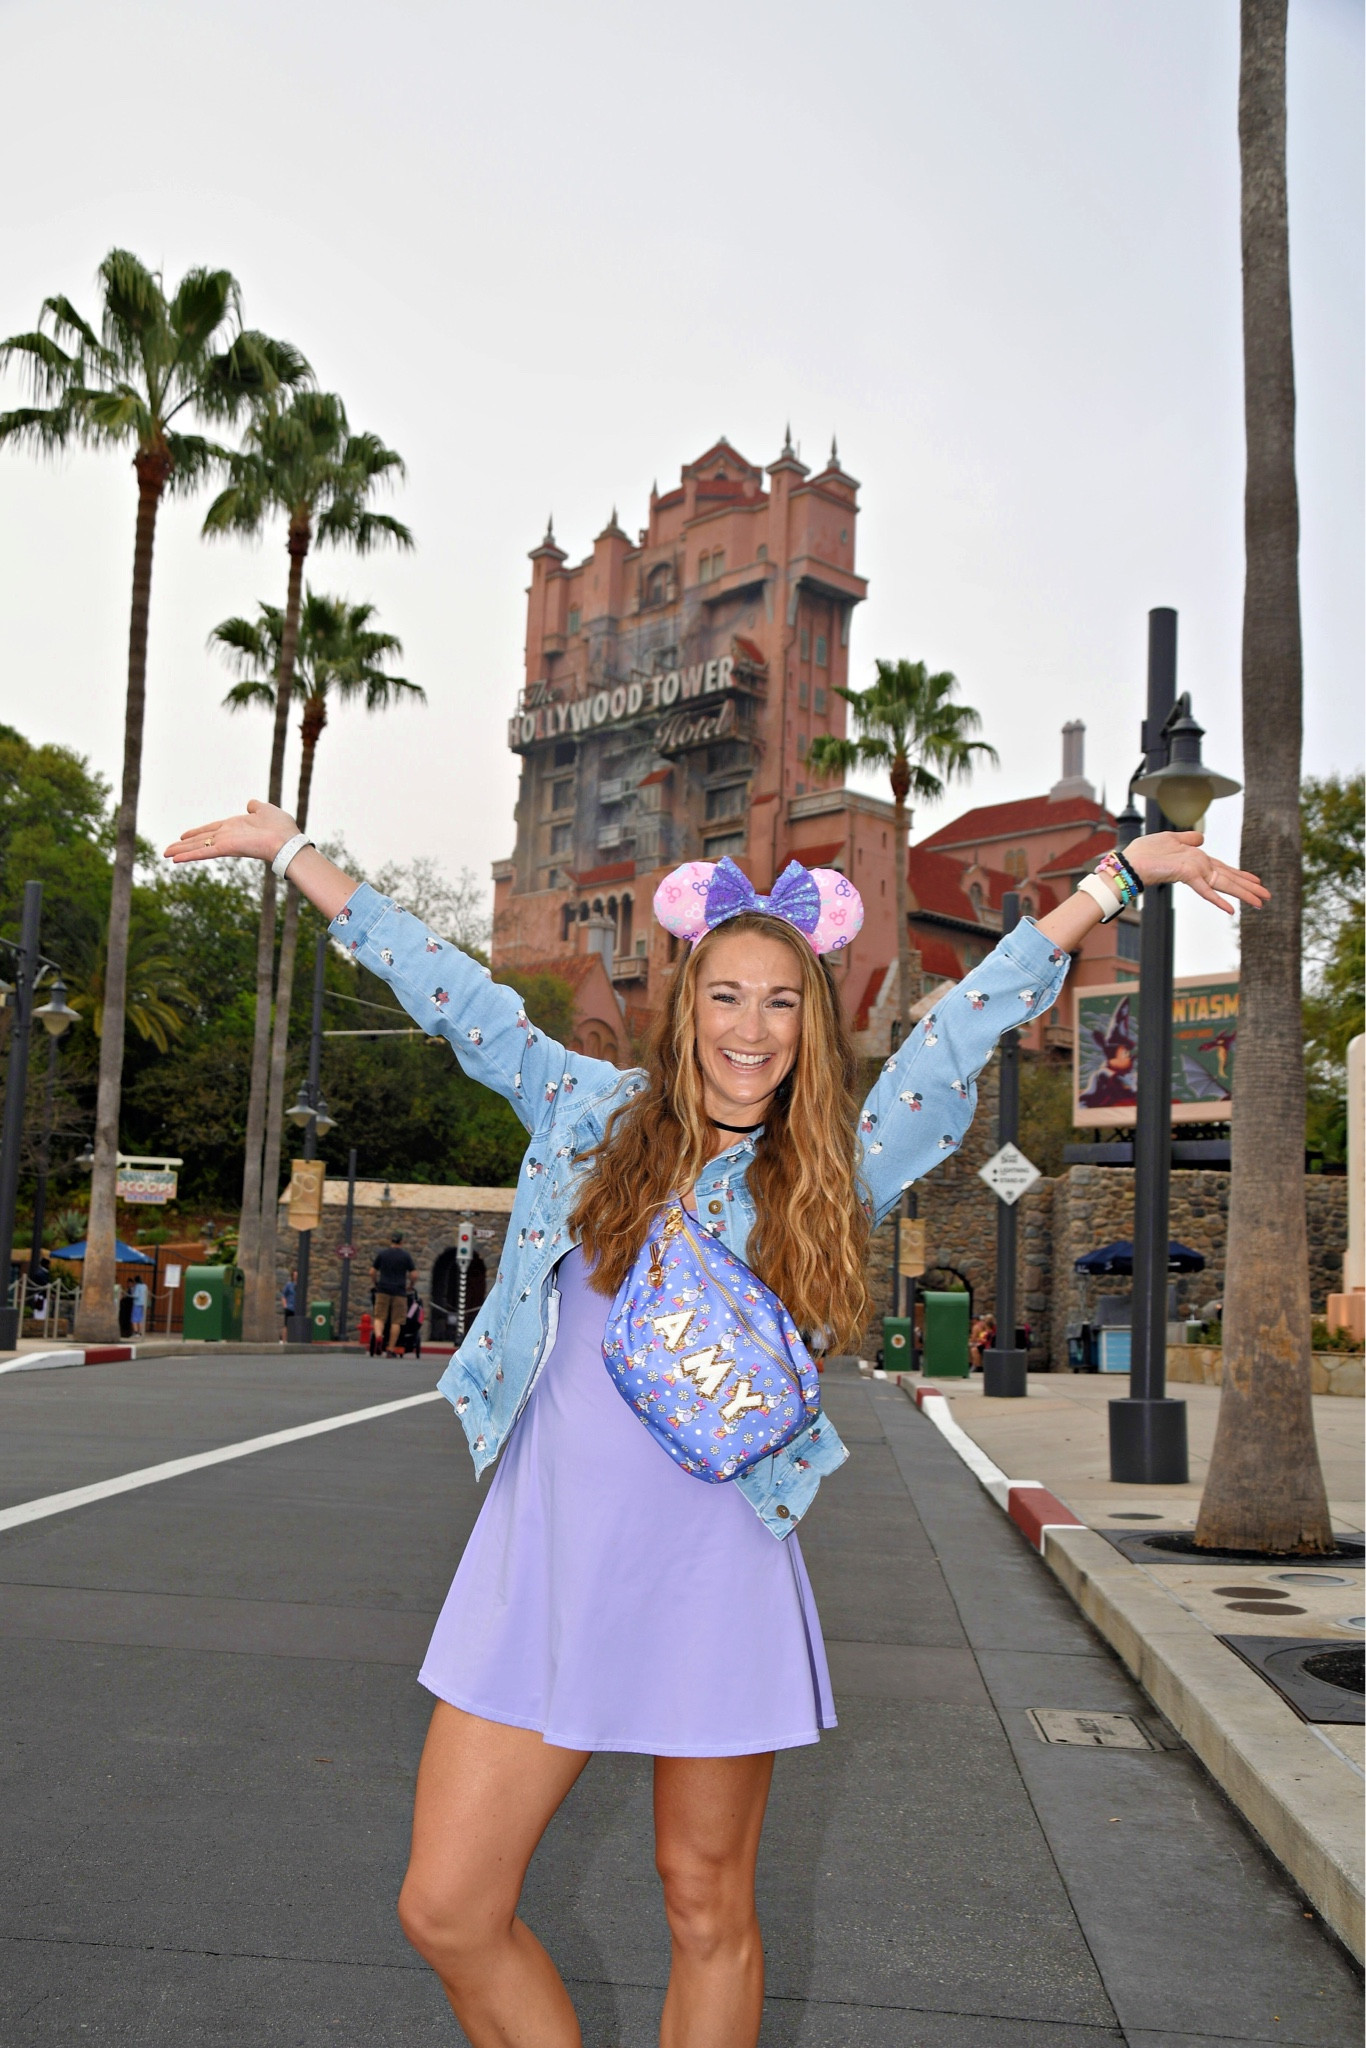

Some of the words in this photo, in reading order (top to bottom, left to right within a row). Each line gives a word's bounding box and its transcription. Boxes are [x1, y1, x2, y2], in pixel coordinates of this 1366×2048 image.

[508, 683, 643, 747] HOLLYWOOD
[651, 656, 734, 705] TOWER
[655, 700, 734, 748] Hotel
[1172, 993, 1240, 1024] NTASM
[118, 1181, 175, 1196] SCOOPS
[652, 1308, 764, 1422] AMY
